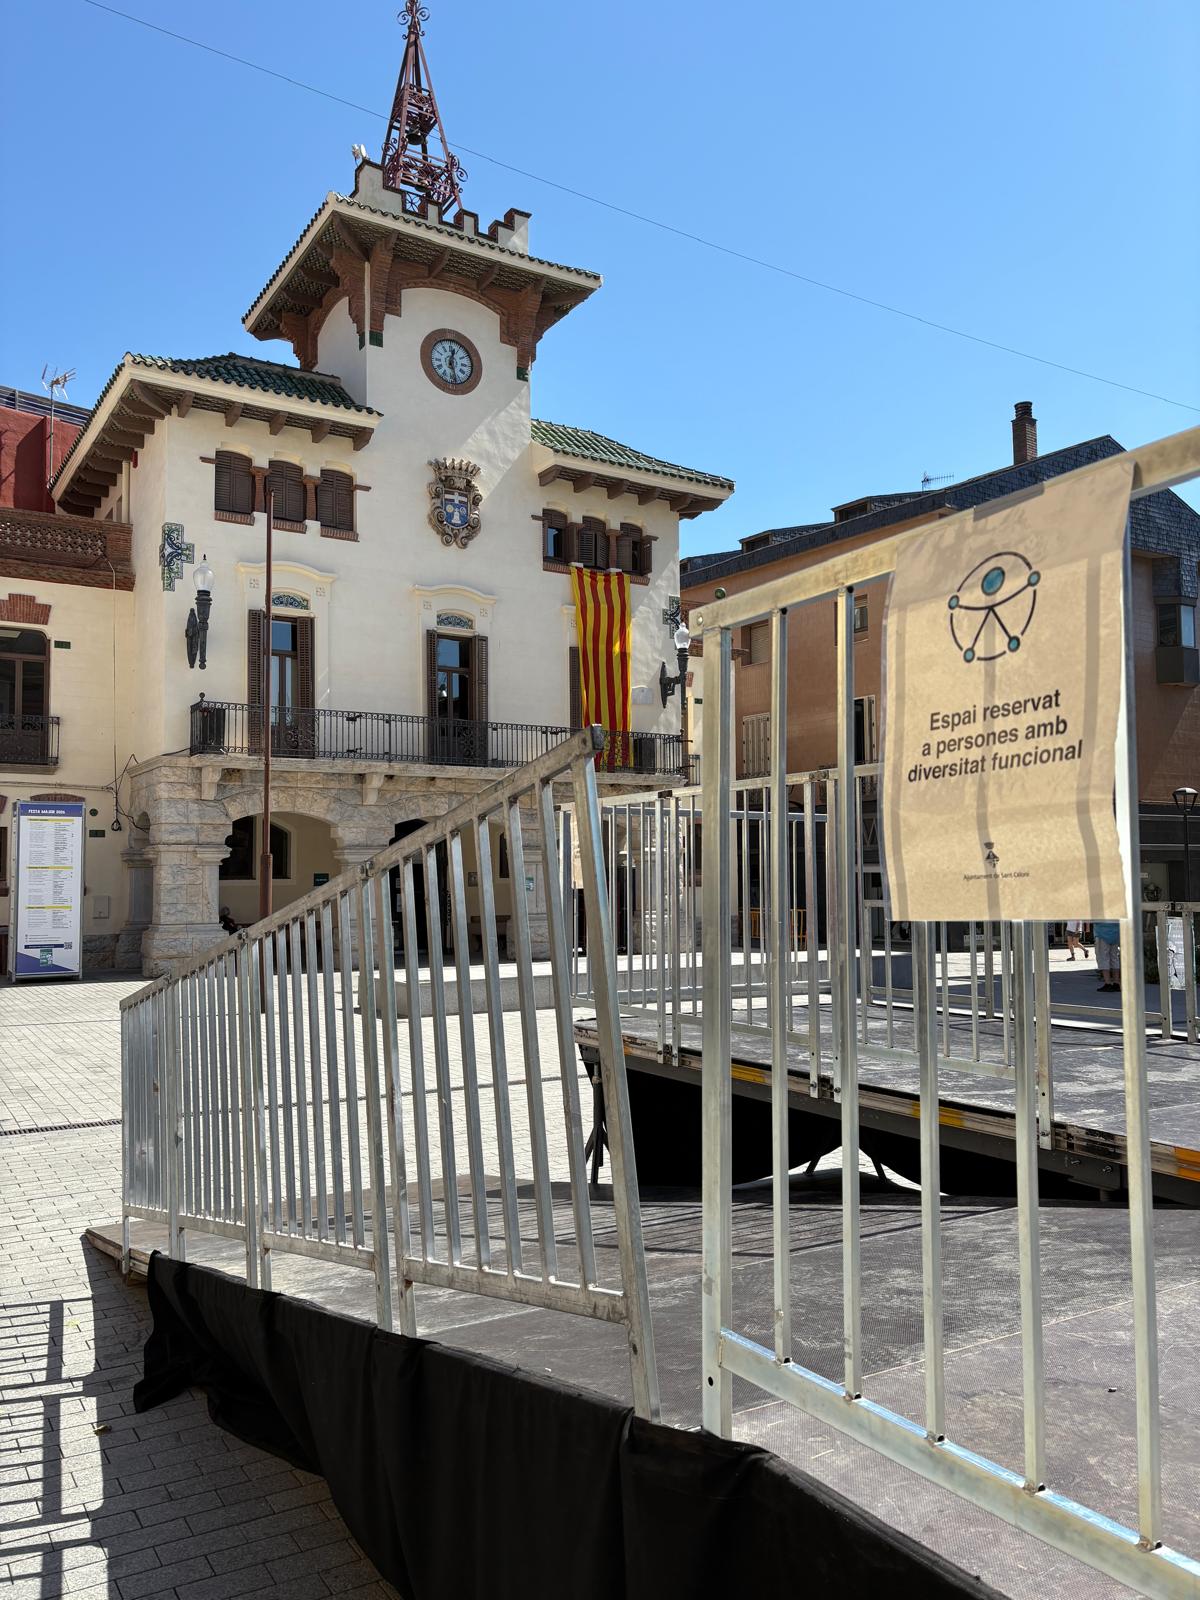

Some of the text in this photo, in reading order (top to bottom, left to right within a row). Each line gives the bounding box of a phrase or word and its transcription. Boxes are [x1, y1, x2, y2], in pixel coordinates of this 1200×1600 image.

[930, 689, 1061, 732] Espai reservat
[922, 715, 1068, 759] a persones amb
[908, 739, 1083, 783] diversitat funcional
